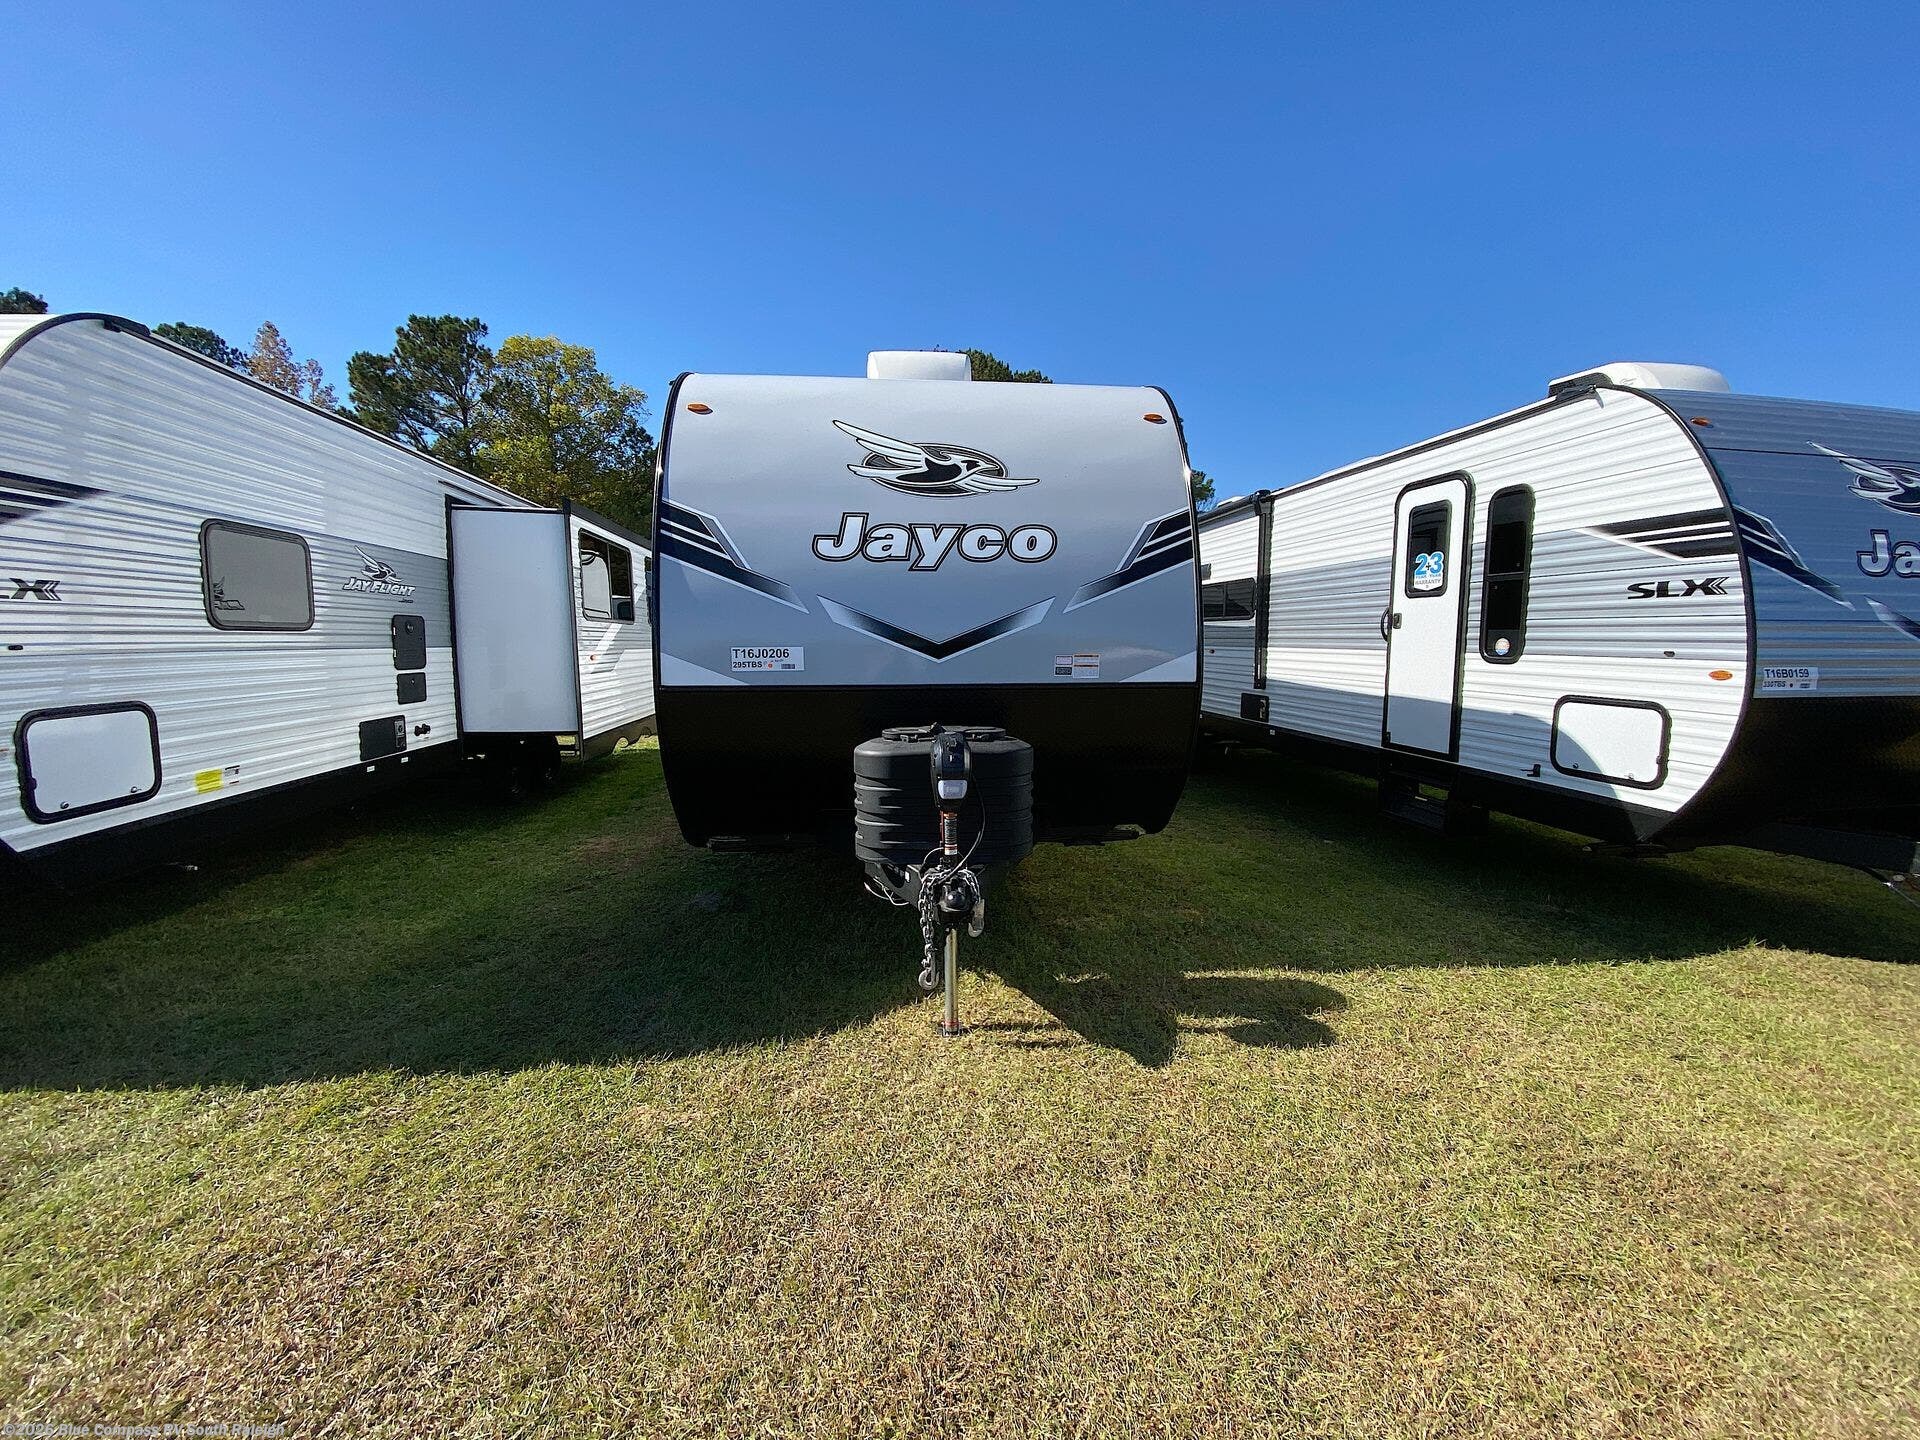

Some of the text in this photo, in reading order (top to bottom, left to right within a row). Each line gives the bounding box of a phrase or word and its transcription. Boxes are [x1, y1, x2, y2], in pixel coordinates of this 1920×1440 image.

[812, 512, 1057, 571] Jayco
[1856, 529, 1920, 578] Ja
[342, 577, 416, 597] JAY FLIGHT
[1627, 577, 1730, 599] SLX
[732, 648, 790, 659] T16J0206
[1764, 668, 1810, 679] T16B0159
